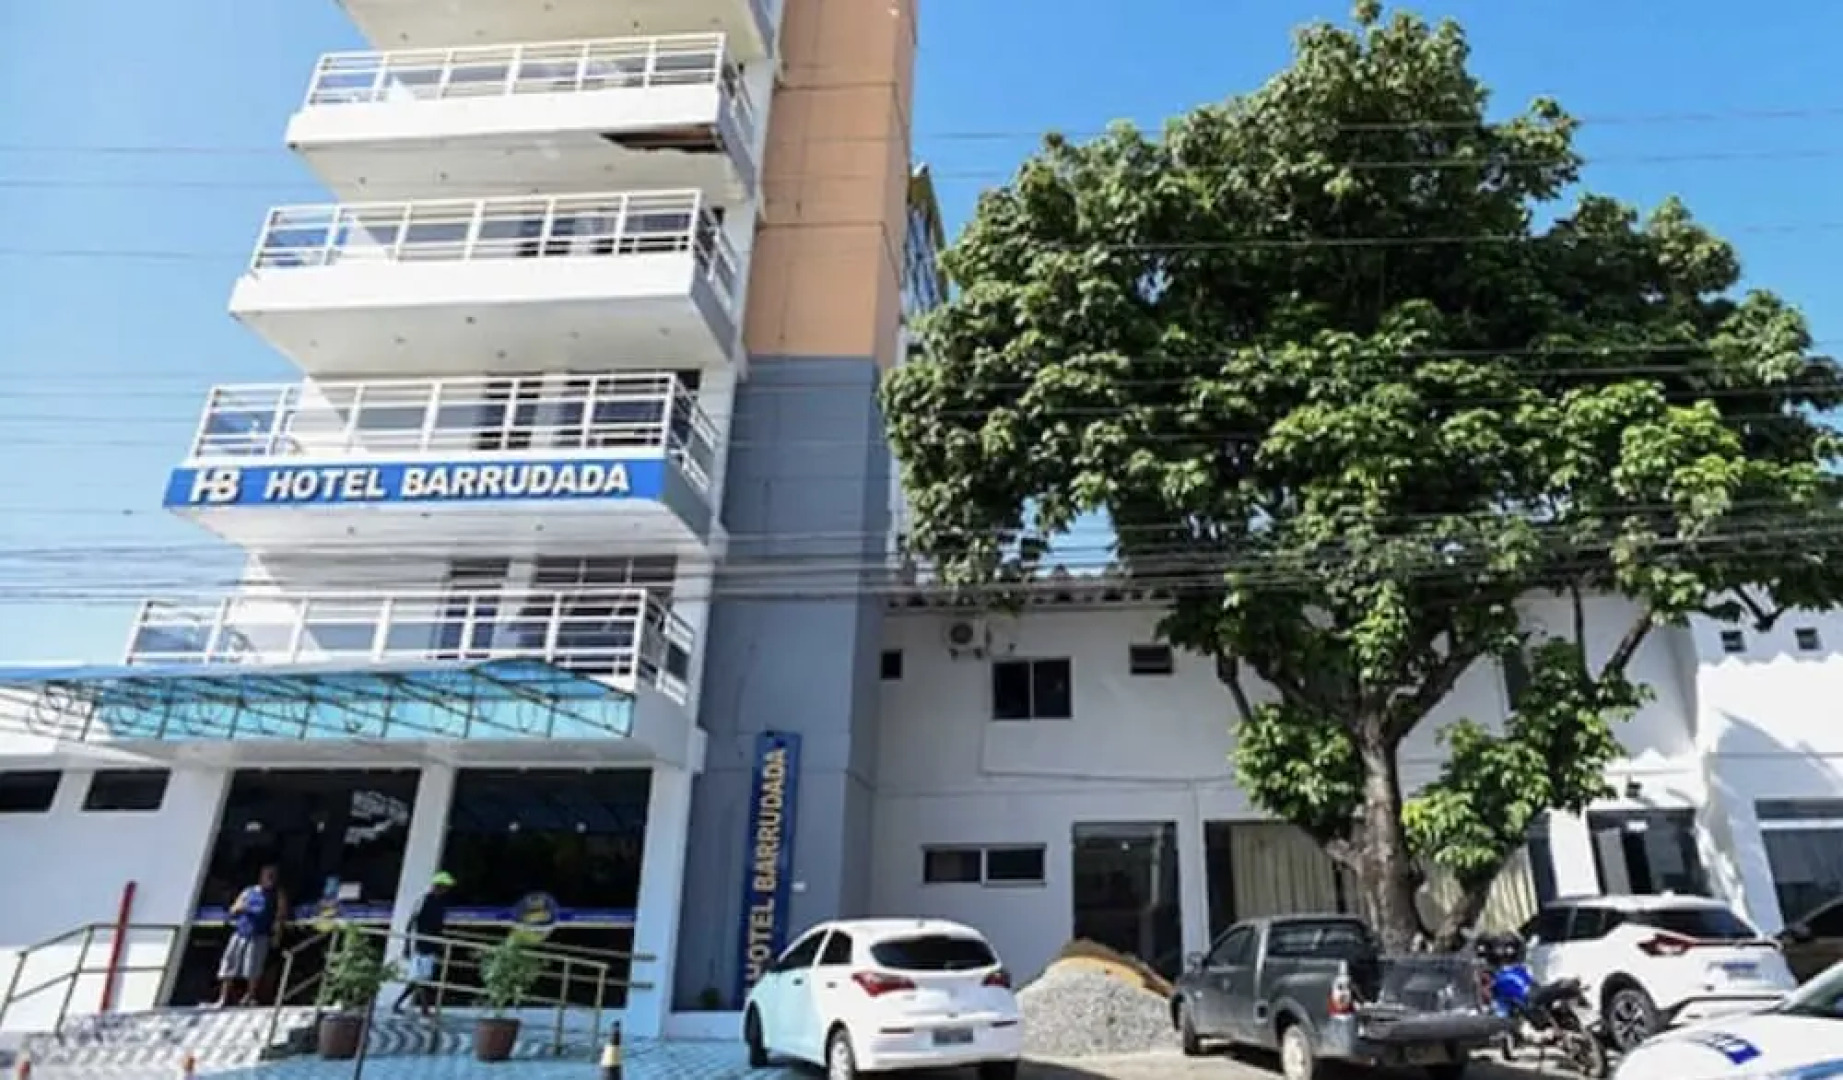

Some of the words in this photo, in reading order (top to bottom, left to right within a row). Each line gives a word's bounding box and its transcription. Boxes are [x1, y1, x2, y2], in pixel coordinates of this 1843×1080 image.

[189, 468, 241, 503] HB
[264, 469, 387, 501] HOTEL
[402, 463, 630, 498] BARRUDADA
[752, 748, 786, 892] BARRUDADA
